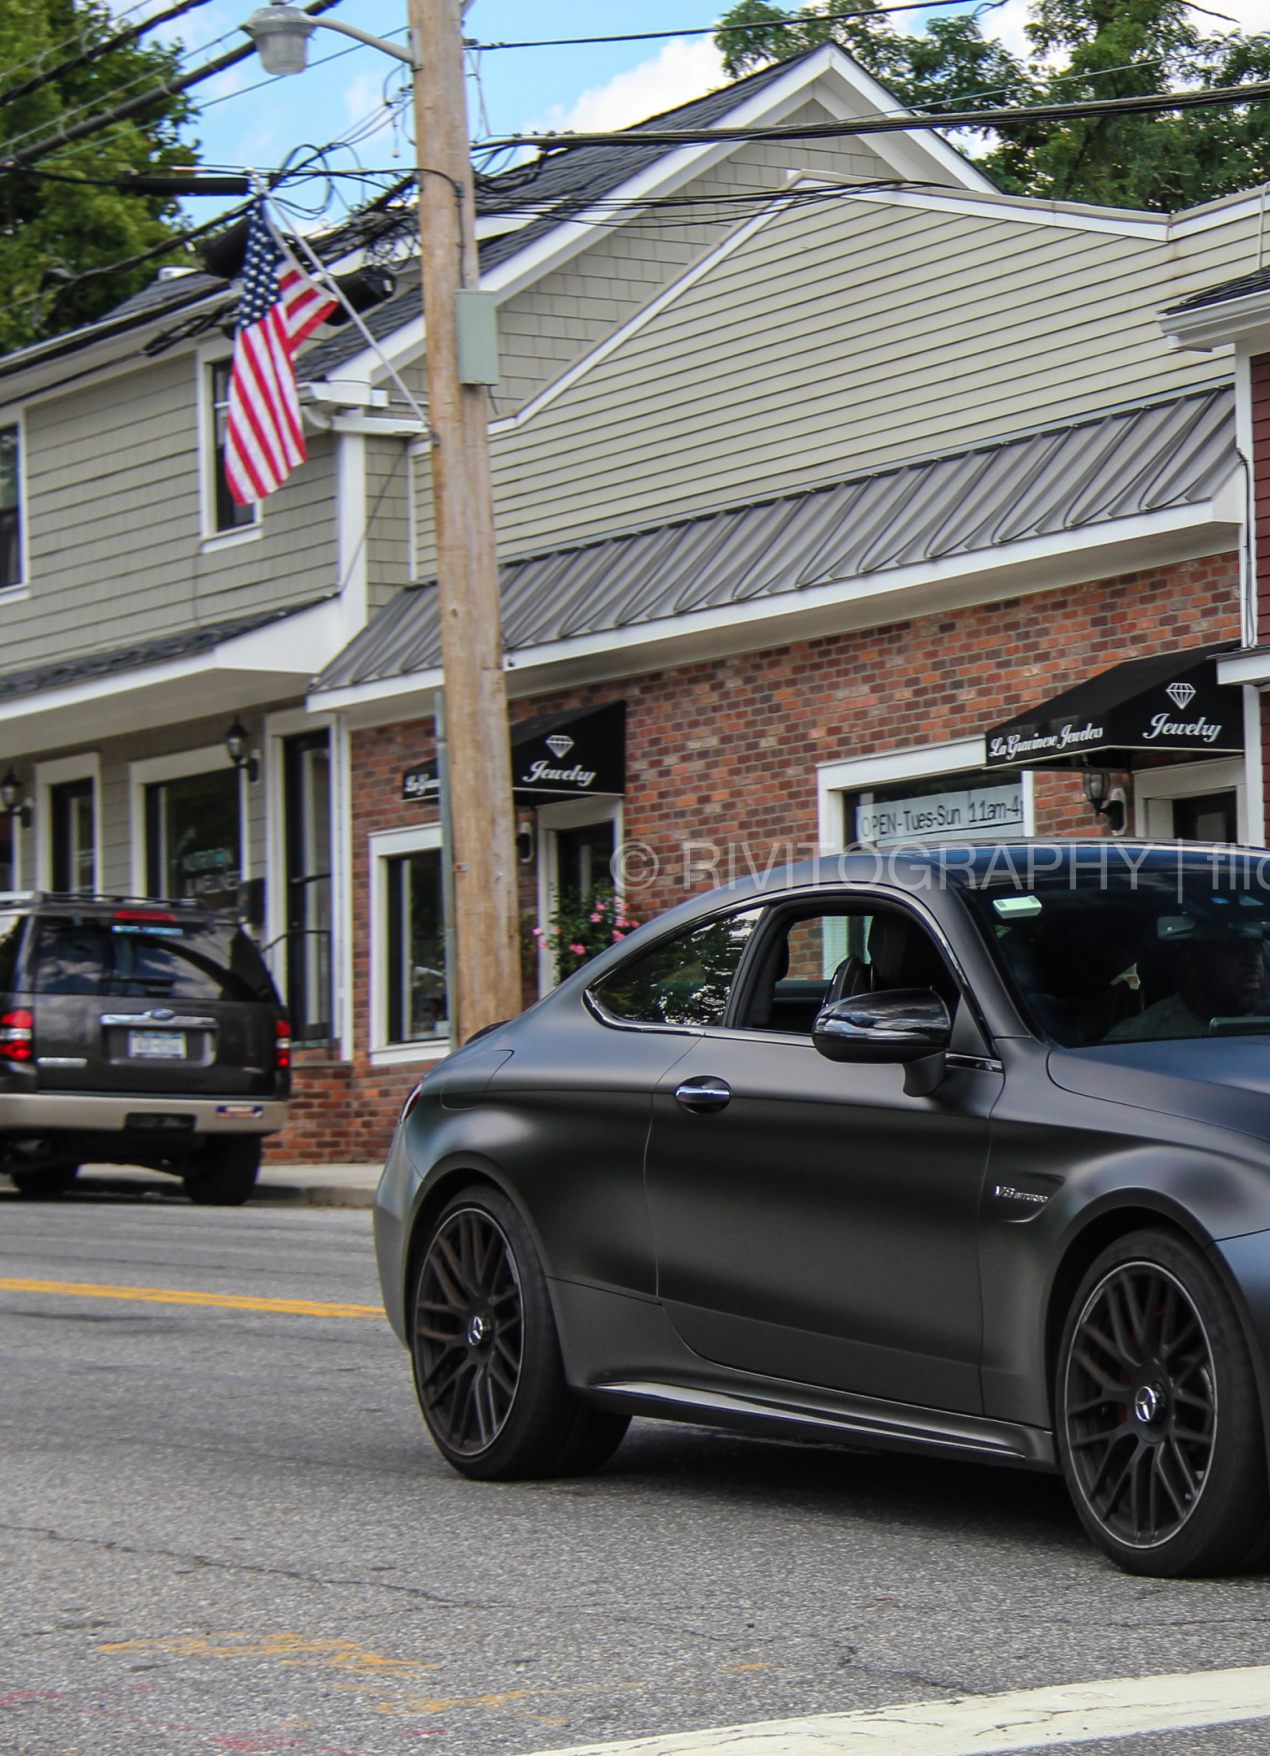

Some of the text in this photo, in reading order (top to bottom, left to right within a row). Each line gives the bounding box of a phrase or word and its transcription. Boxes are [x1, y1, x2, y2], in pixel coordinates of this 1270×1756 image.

[989, 736, 1006, 757] La
[1056, 722, 1104, 749] Jewelers
[1142, 713, 1222, 743] Jewelry
[522, 760, 597, 787] Jewelry
